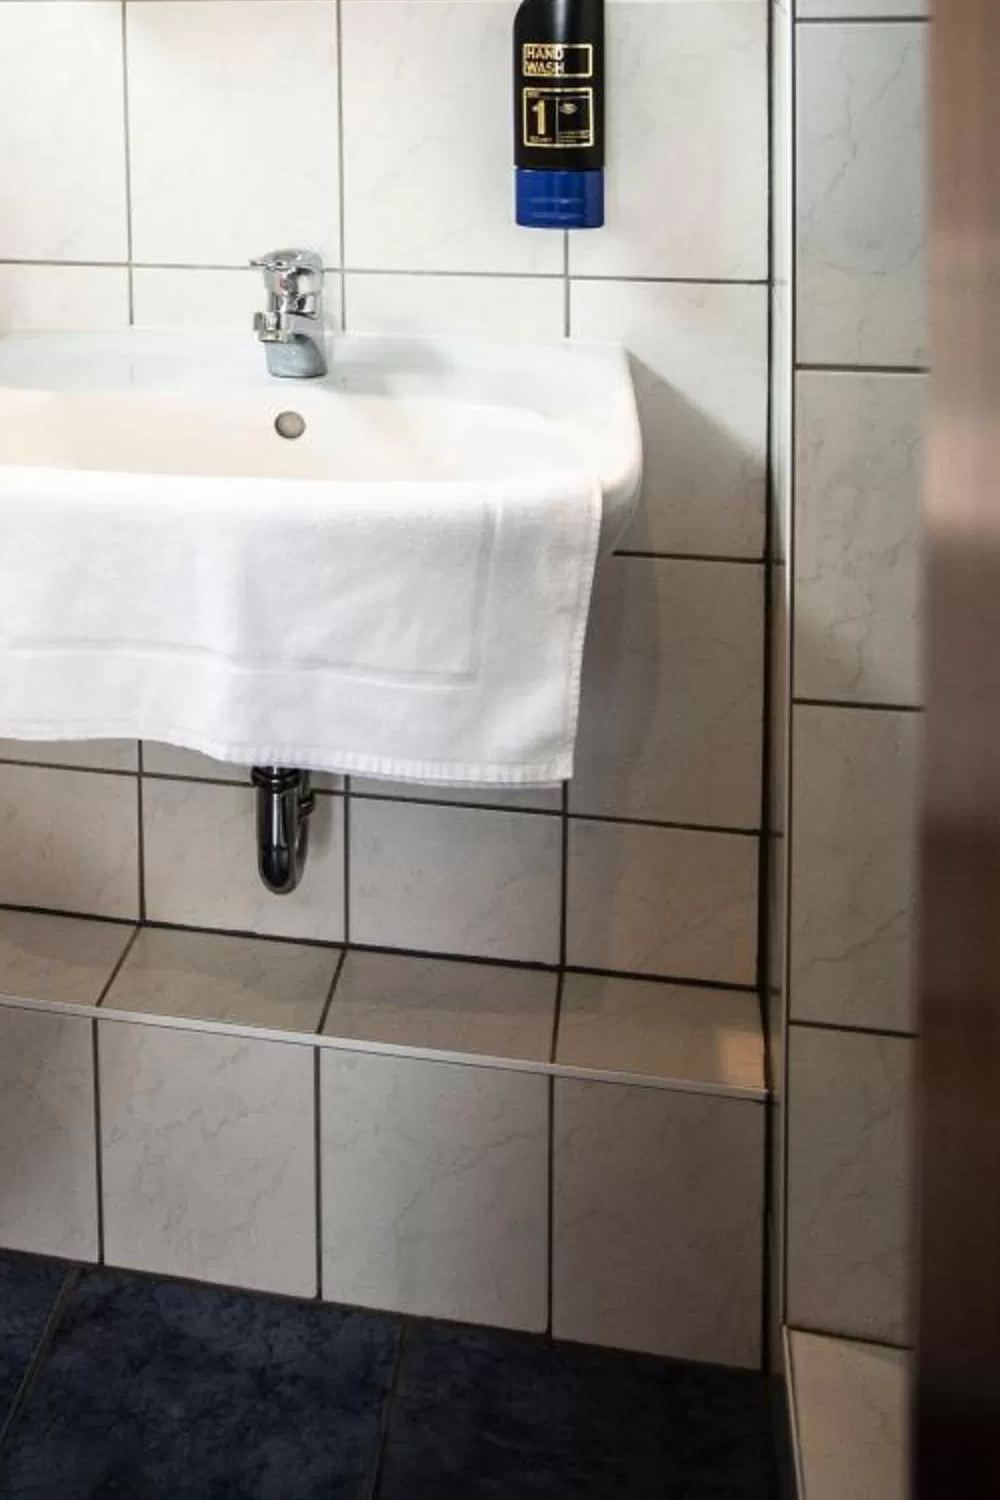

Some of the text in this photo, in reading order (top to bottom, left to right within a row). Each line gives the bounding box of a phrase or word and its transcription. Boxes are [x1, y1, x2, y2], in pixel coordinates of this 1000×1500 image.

[527, 47, 564, 60] HAND
[526, 61, 565, 73] WASH
[531, 100, 546, 135] 1
